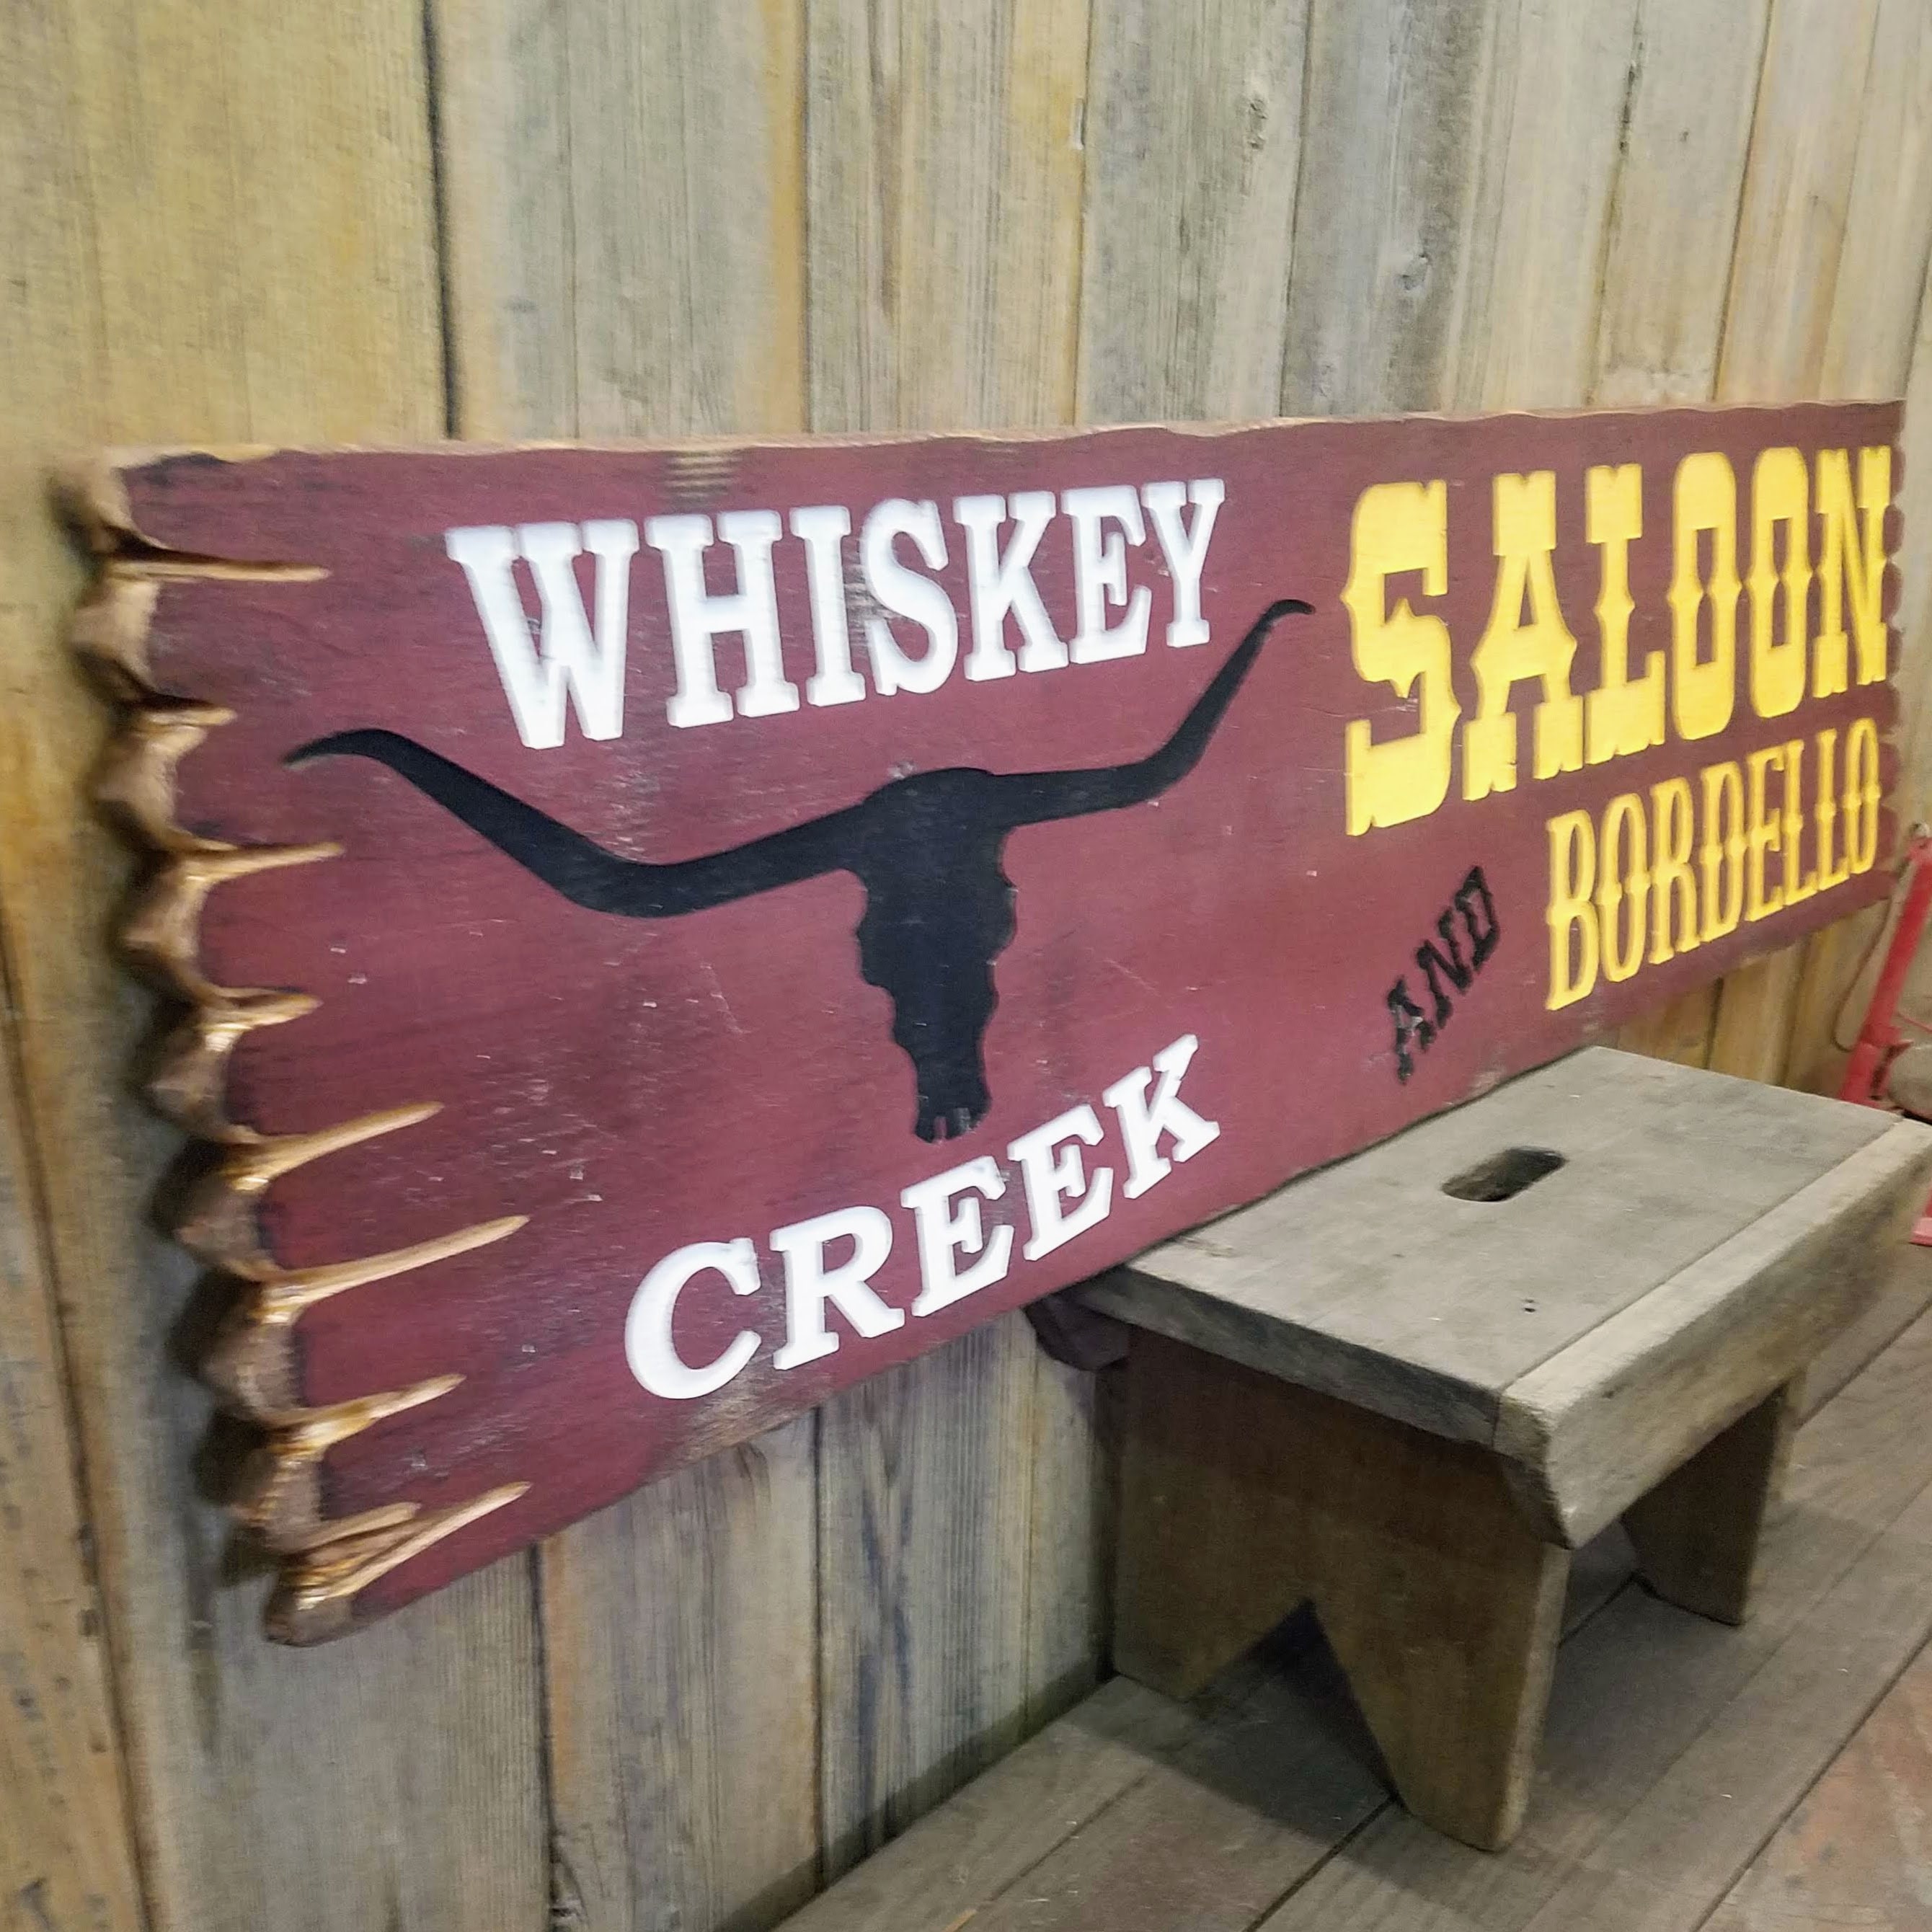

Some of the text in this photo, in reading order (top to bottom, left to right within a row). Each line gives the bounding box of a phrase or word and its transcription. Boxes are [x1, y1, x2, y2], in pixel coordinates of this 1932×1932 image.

[443, 477, 1227, 752] WHISKEY
[1340, 444, 1892, 838] SALOON
[1386, 867, 1499, 1082] AND
[1546, 717, 1882, 1011] BORDELLO
[624, 1032, 1223, 1401] CREEK
